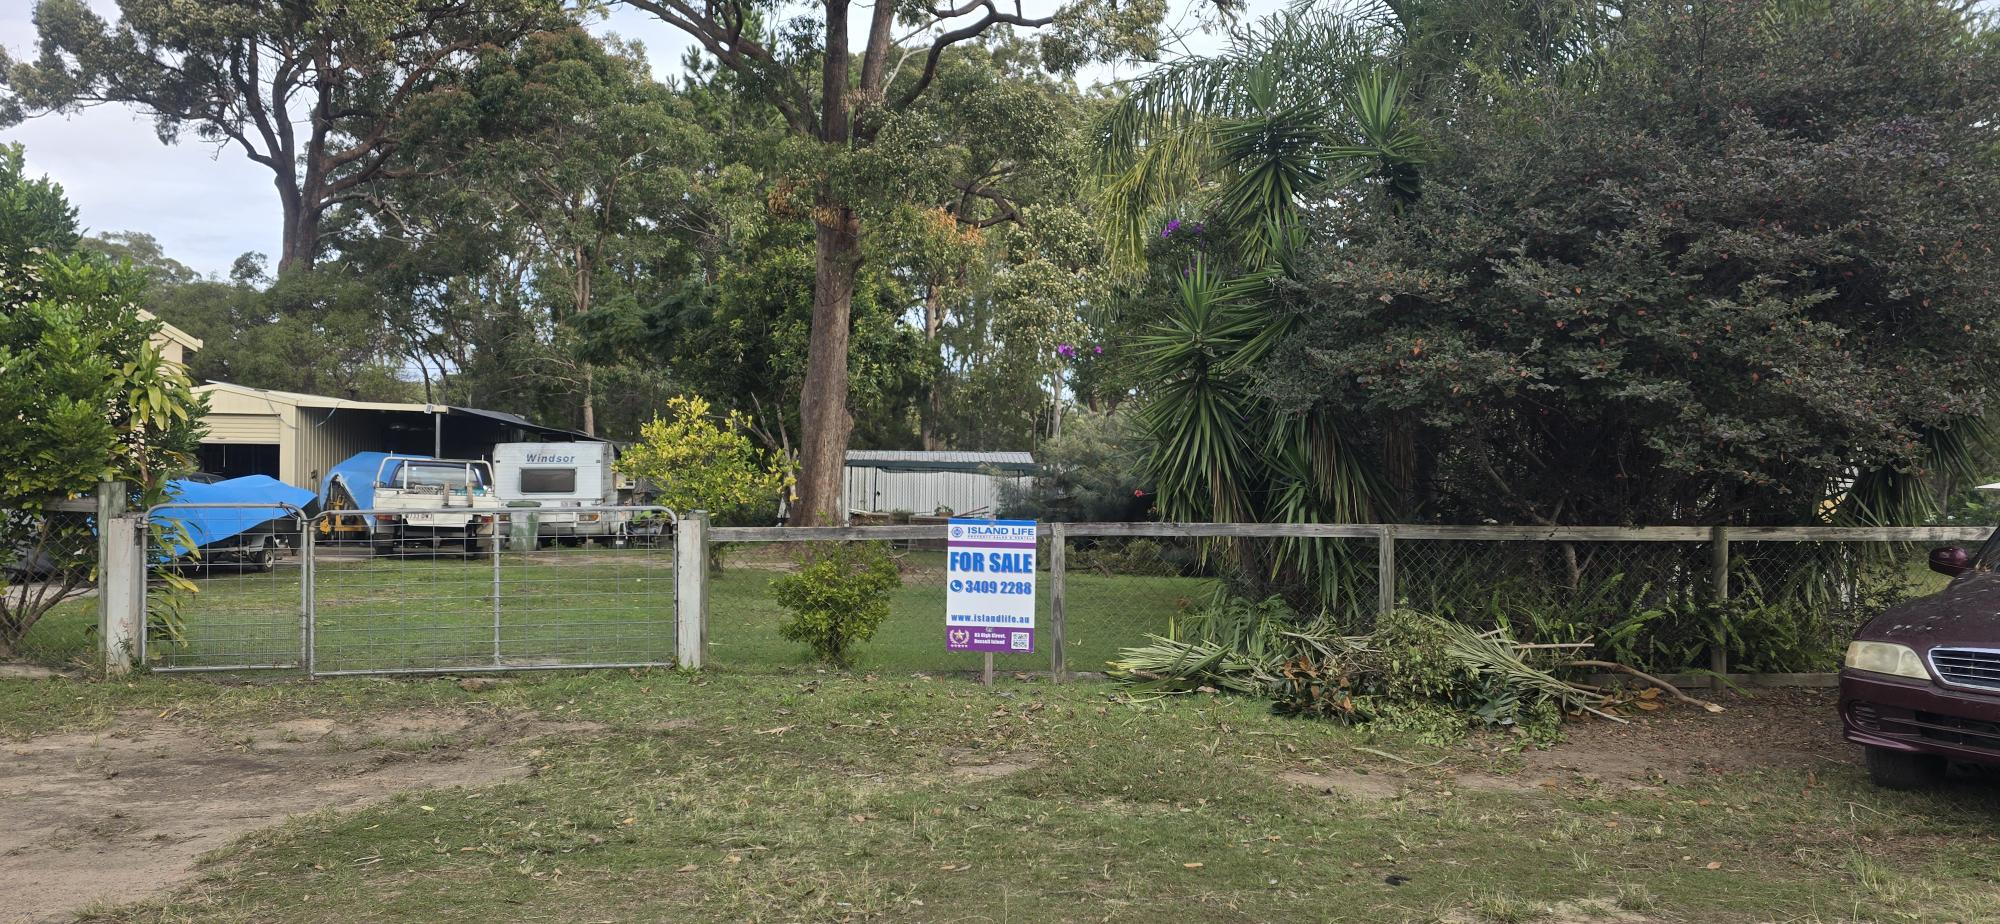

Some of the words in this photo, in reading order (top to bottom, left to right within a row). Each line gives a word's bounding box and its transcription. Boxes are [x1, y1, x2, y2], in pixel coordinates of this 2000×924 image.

[526, 453, 575, 463] Windsor
[967, 526, 1009, 535] ISLAND
[1011, 527, 1035, 536] LIFE
[950, 552, 985, 573] FOR
[989, 552, 1033, 573] SALE
[965, 580, 998, 593] 3409
[1000, 581, 1032, 595] 2288
[951, 614, 1030, 624] www.islandlife.au
